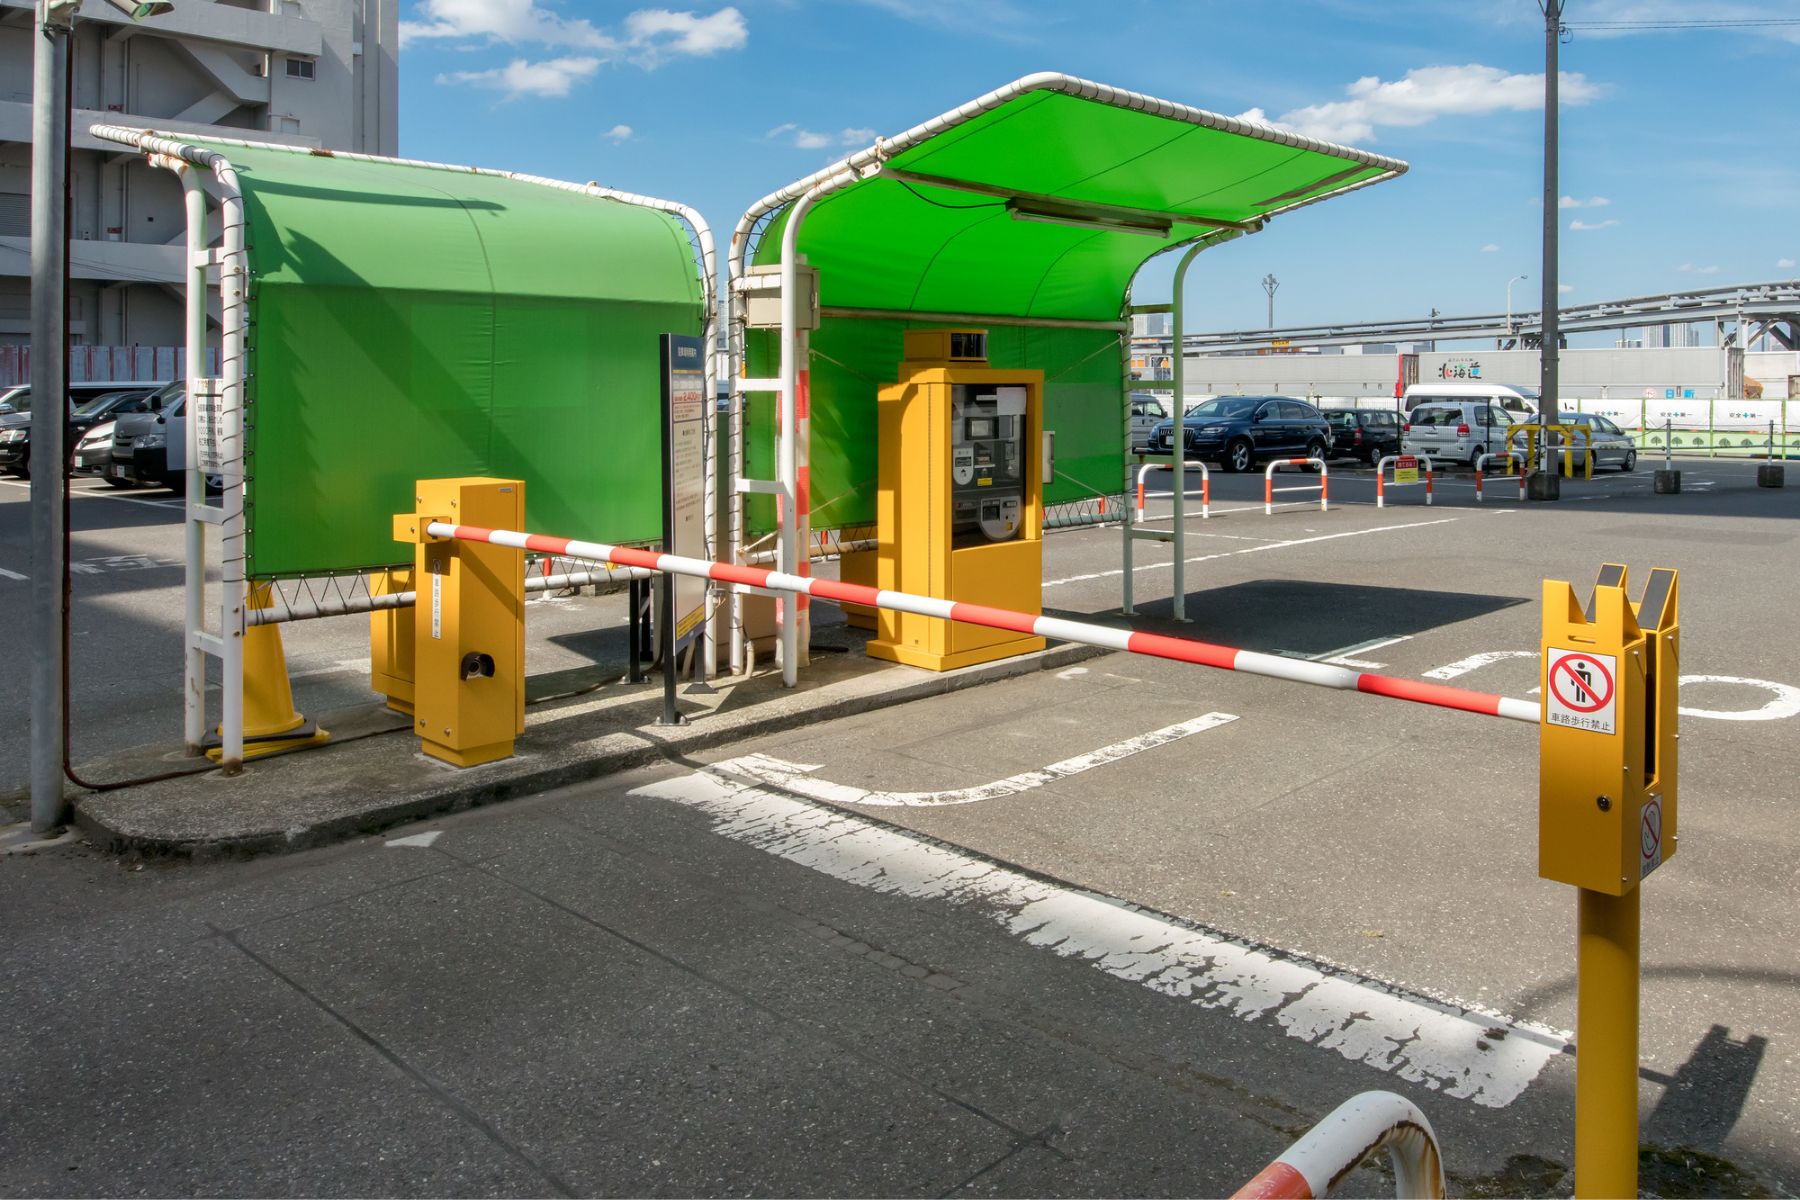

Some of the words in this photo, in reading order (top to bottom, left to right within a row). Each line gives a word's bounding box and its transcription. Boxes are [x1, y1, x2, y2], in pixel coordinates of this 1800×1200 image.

[1438, 362, 1482, 379] 北海道
[1551, 712, 1611, 731] 車路歩行禁止
